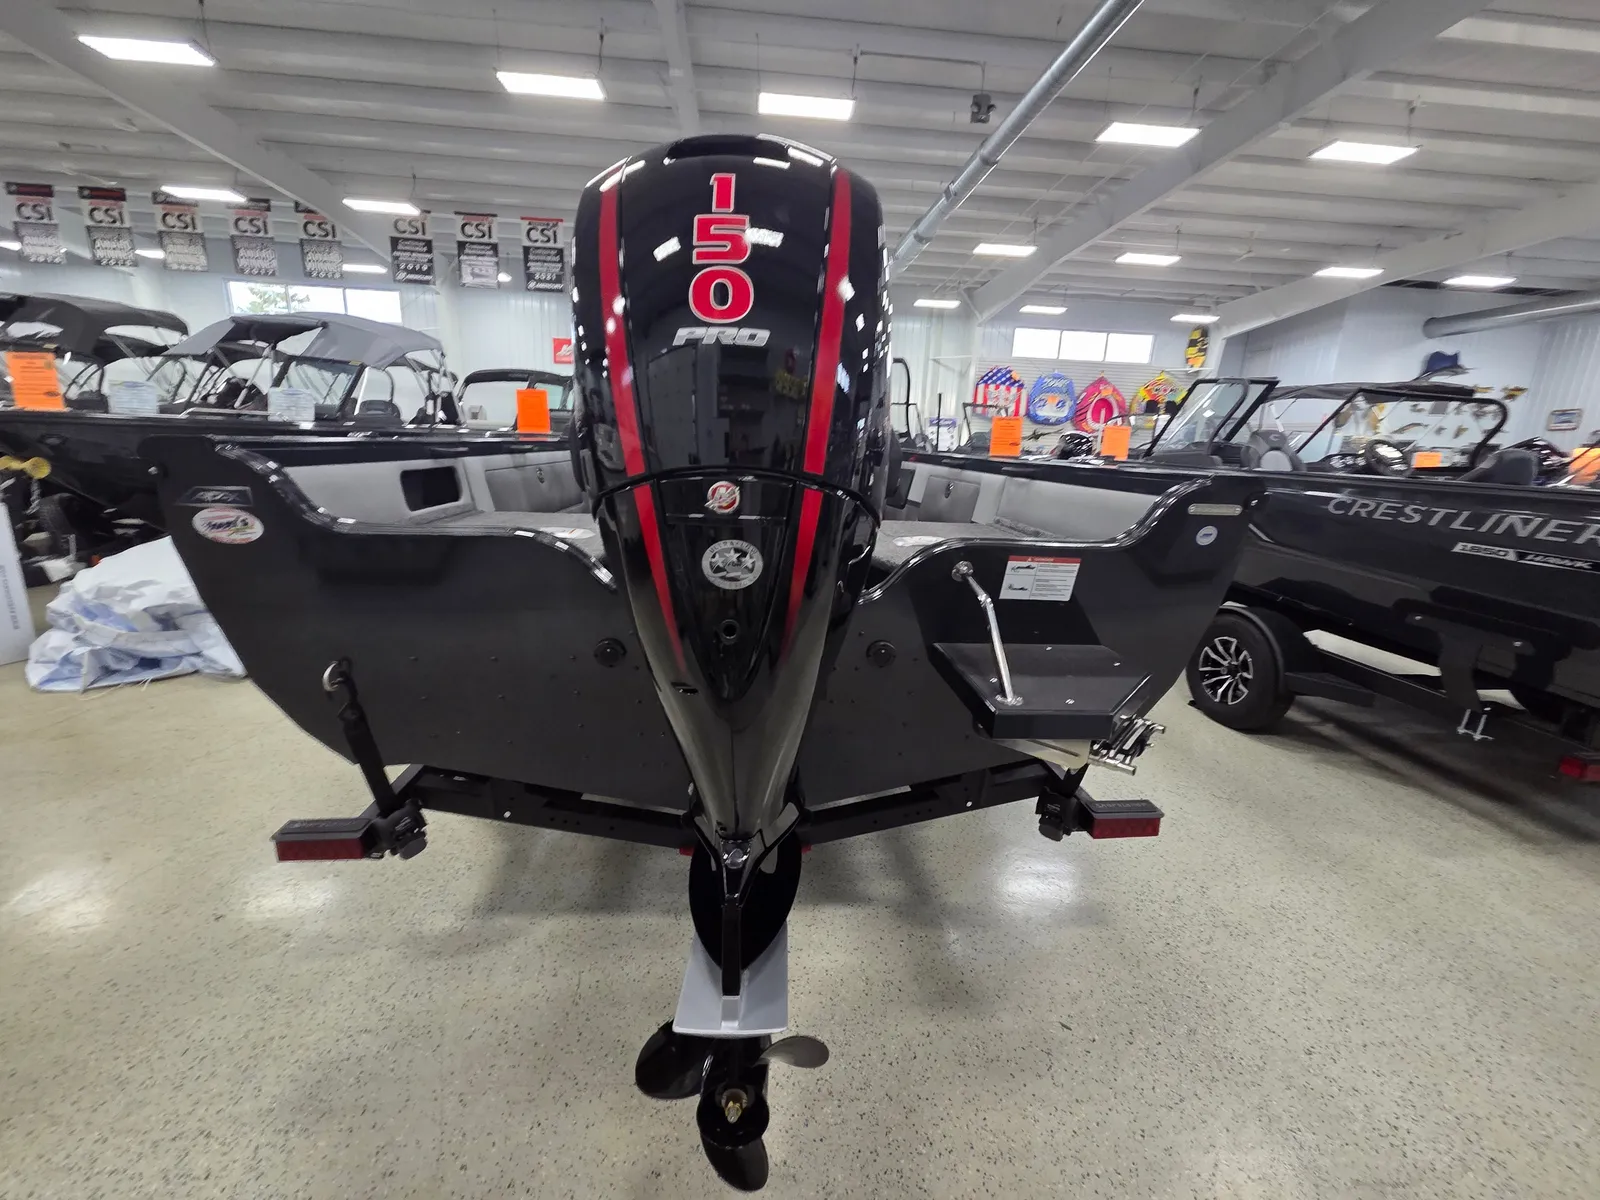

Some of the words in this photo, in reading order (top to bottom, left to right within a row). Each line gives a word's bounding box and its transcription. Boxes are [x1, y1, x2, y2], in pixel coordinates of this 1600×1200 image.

[16, 202, 54, 221] CSI
[90, 207, 124, 226] CSI
[162, 212, 196, 231] CSI
[234, 216, 269, 235] CSI
[303, 220, 337, 239] CSI
[394, 218, 426, 236] CSI
[461, 222, 492, 239] CSI
[526, 227, 557, 244] CSI
[689, 173, 754, 323] 150
[672, 326, 771, 347] PRO
